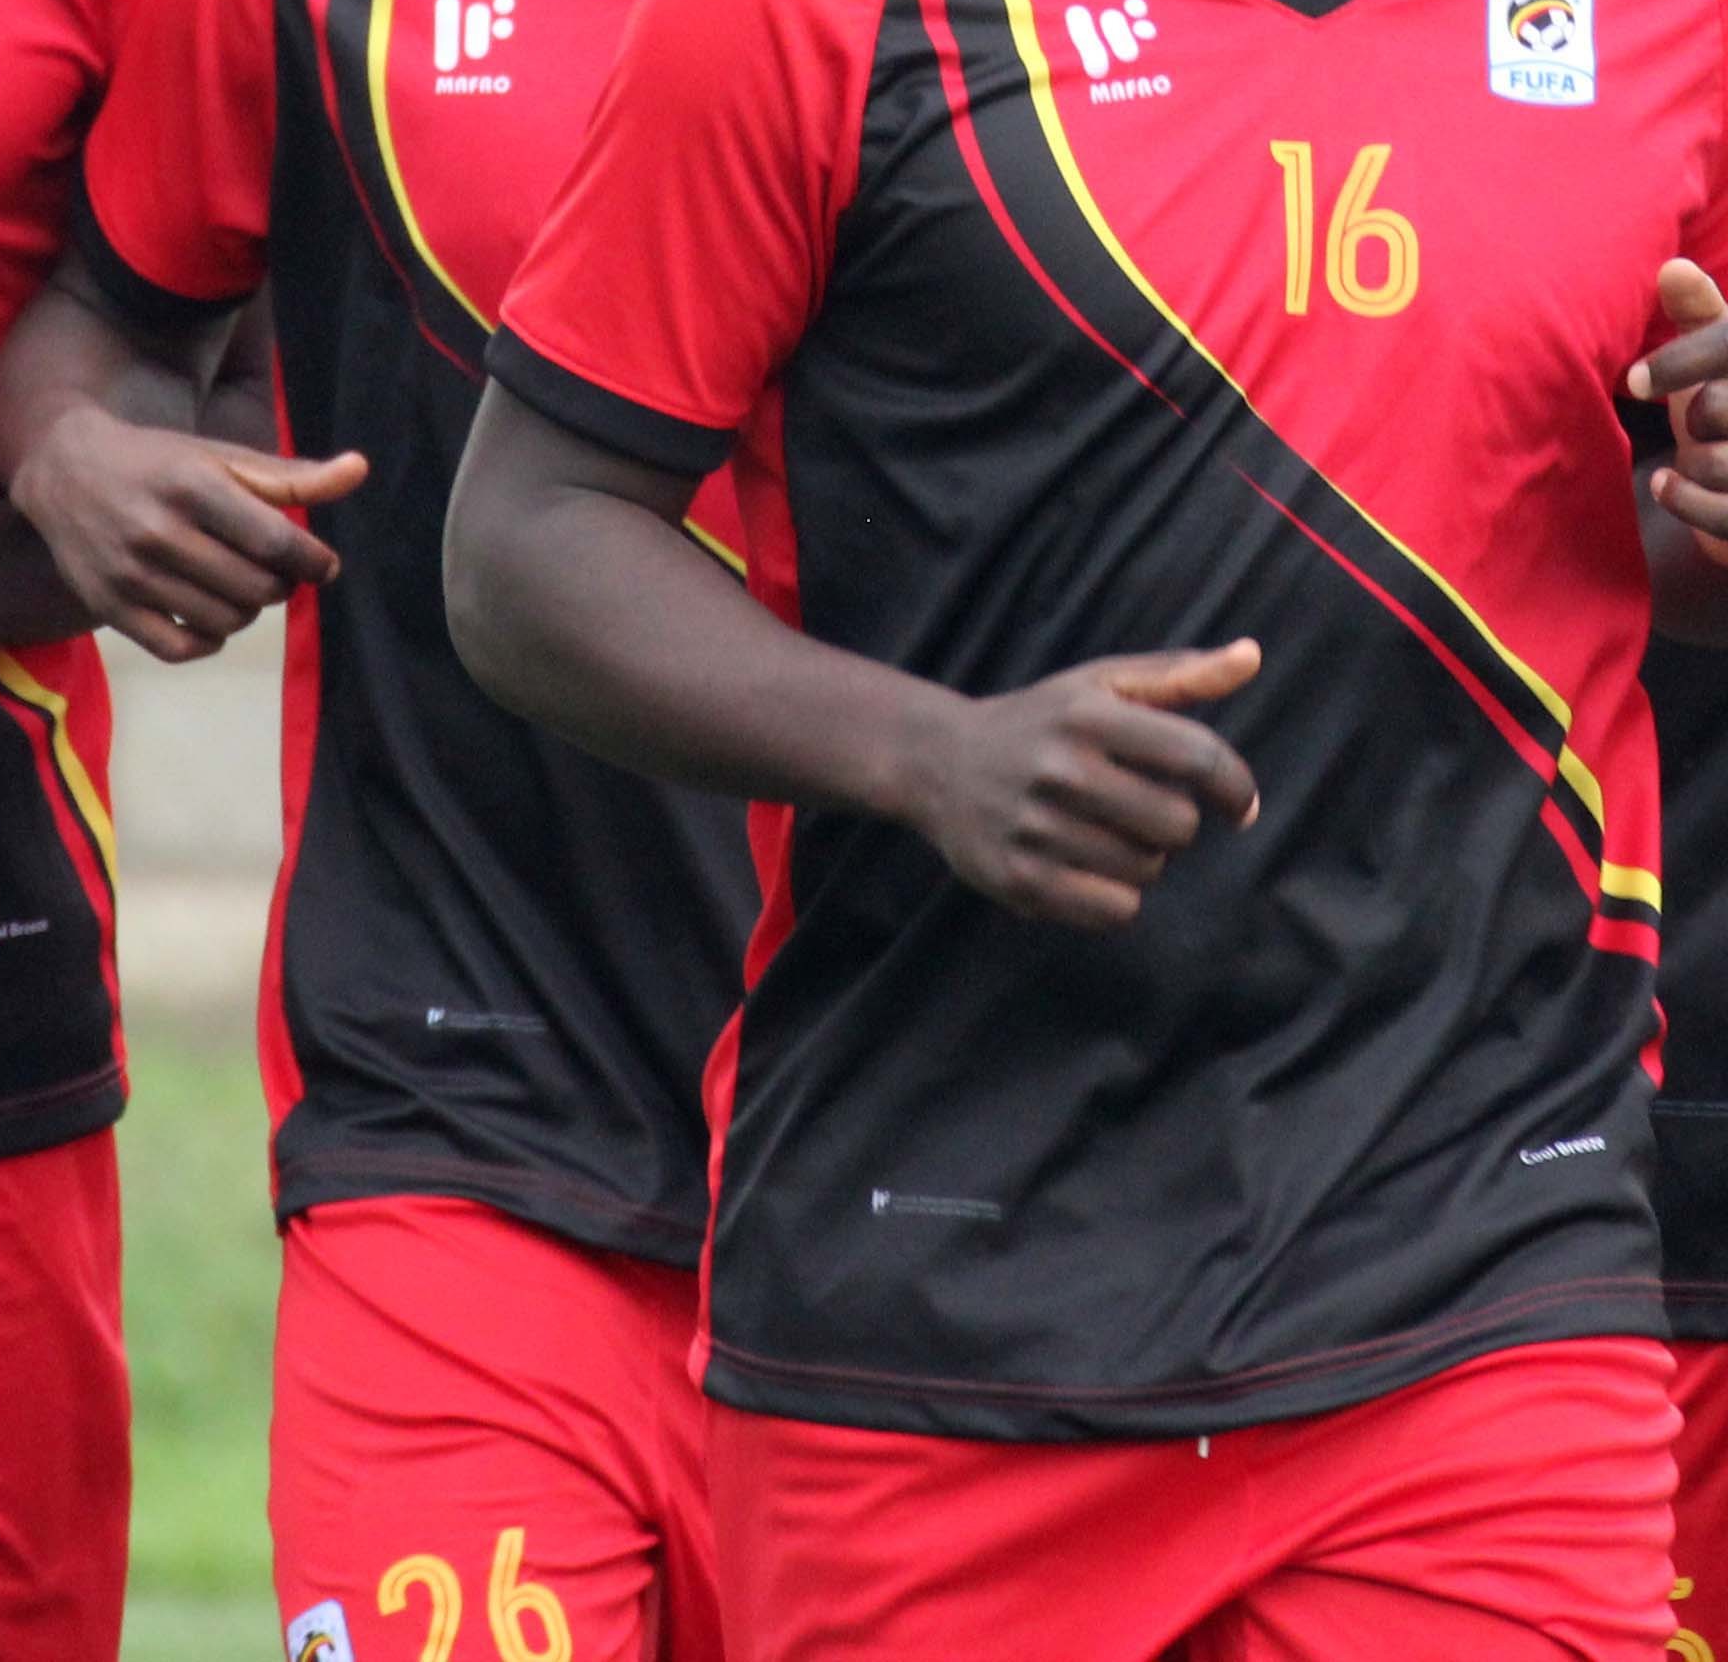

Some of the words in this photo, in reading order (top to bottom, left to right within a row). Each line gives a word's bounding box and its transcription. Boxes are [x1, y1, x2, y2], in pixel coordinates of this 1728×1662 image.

[1509, 70, 1576, 93] FUFA
[1269, 140, 1421, 318] 16
[1519, 1144, 1559, 1166] Cool
[1554, 1136, 1607, 1157] Breeze
[376, 1526, 573, 1662] 26
